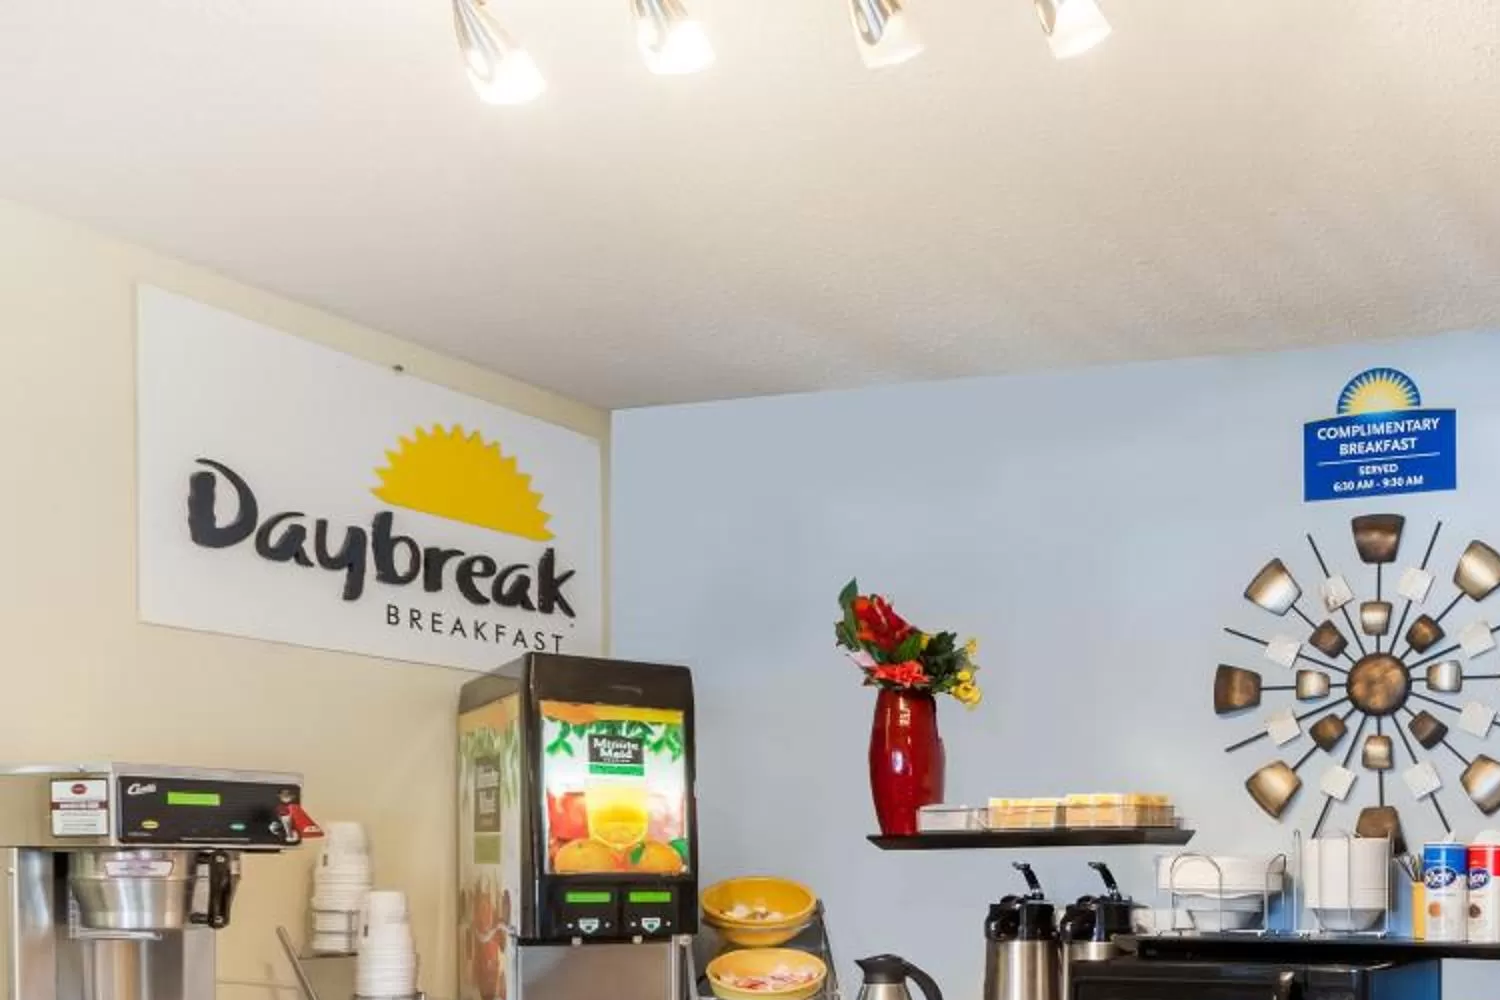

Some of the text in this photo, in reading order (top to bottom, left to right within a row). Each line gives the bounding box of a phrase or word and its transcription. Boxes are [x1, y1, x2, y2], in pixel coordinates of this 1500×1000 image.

[1316, 417, 1441, 441] COMPLIMENTARY
[1339, 437, 1418, 456] BREAKFAST
[1358, 463, 1399, 476] SERVED
[1356, 479, 1375, 491] AM
[1405, 474, 1425, 486] AM
[187, 457, 577, 618] Daybreak
[386, 603, 564, 653] BREAKFAST
